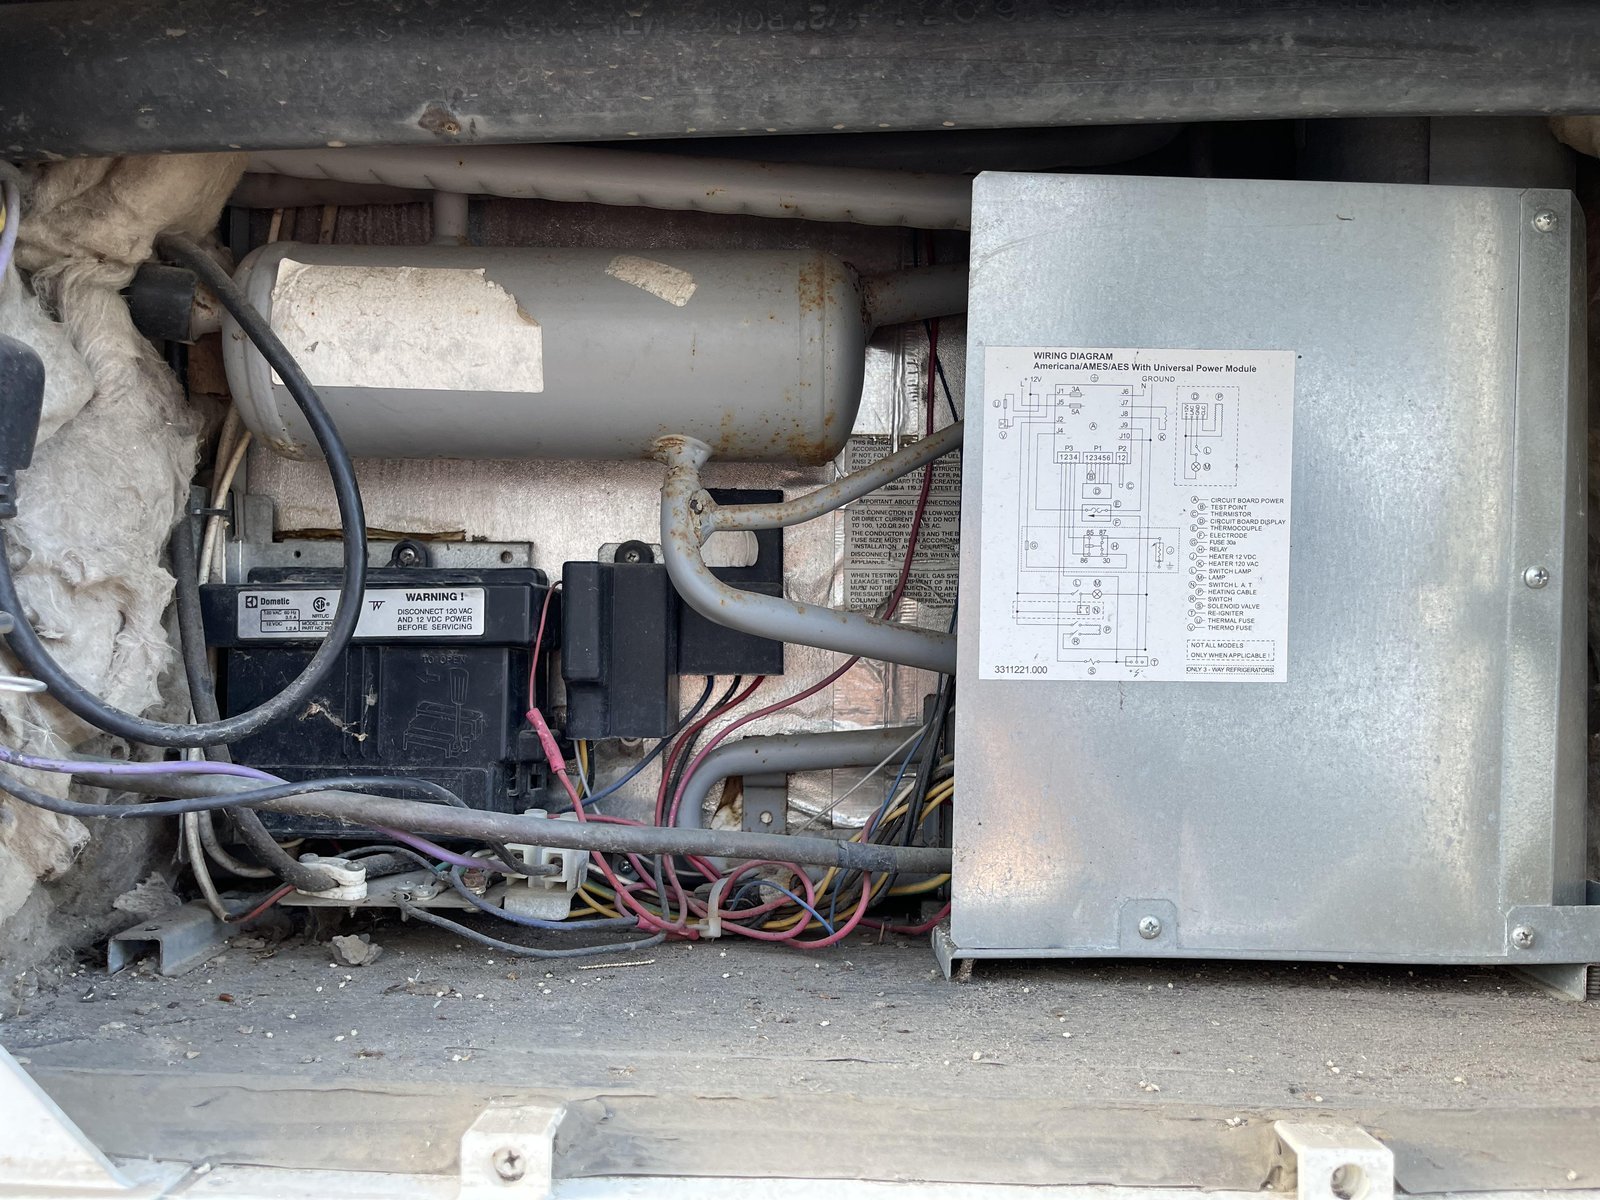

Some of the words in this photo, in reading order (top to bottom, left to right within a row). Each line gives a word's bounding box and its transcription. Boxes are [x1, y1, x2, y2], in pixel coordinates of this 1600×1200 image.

[1033, 362, 1129, 370] Americana/AMES/AES
[1132, 363, 1151, 371] With
[1154, 364, 1194, 372] Universal
[406, 593, 458, 601] WARNING
[440, 655, 466, 664] OPEN
[994, 666, 1047, 674] 3311221.000
